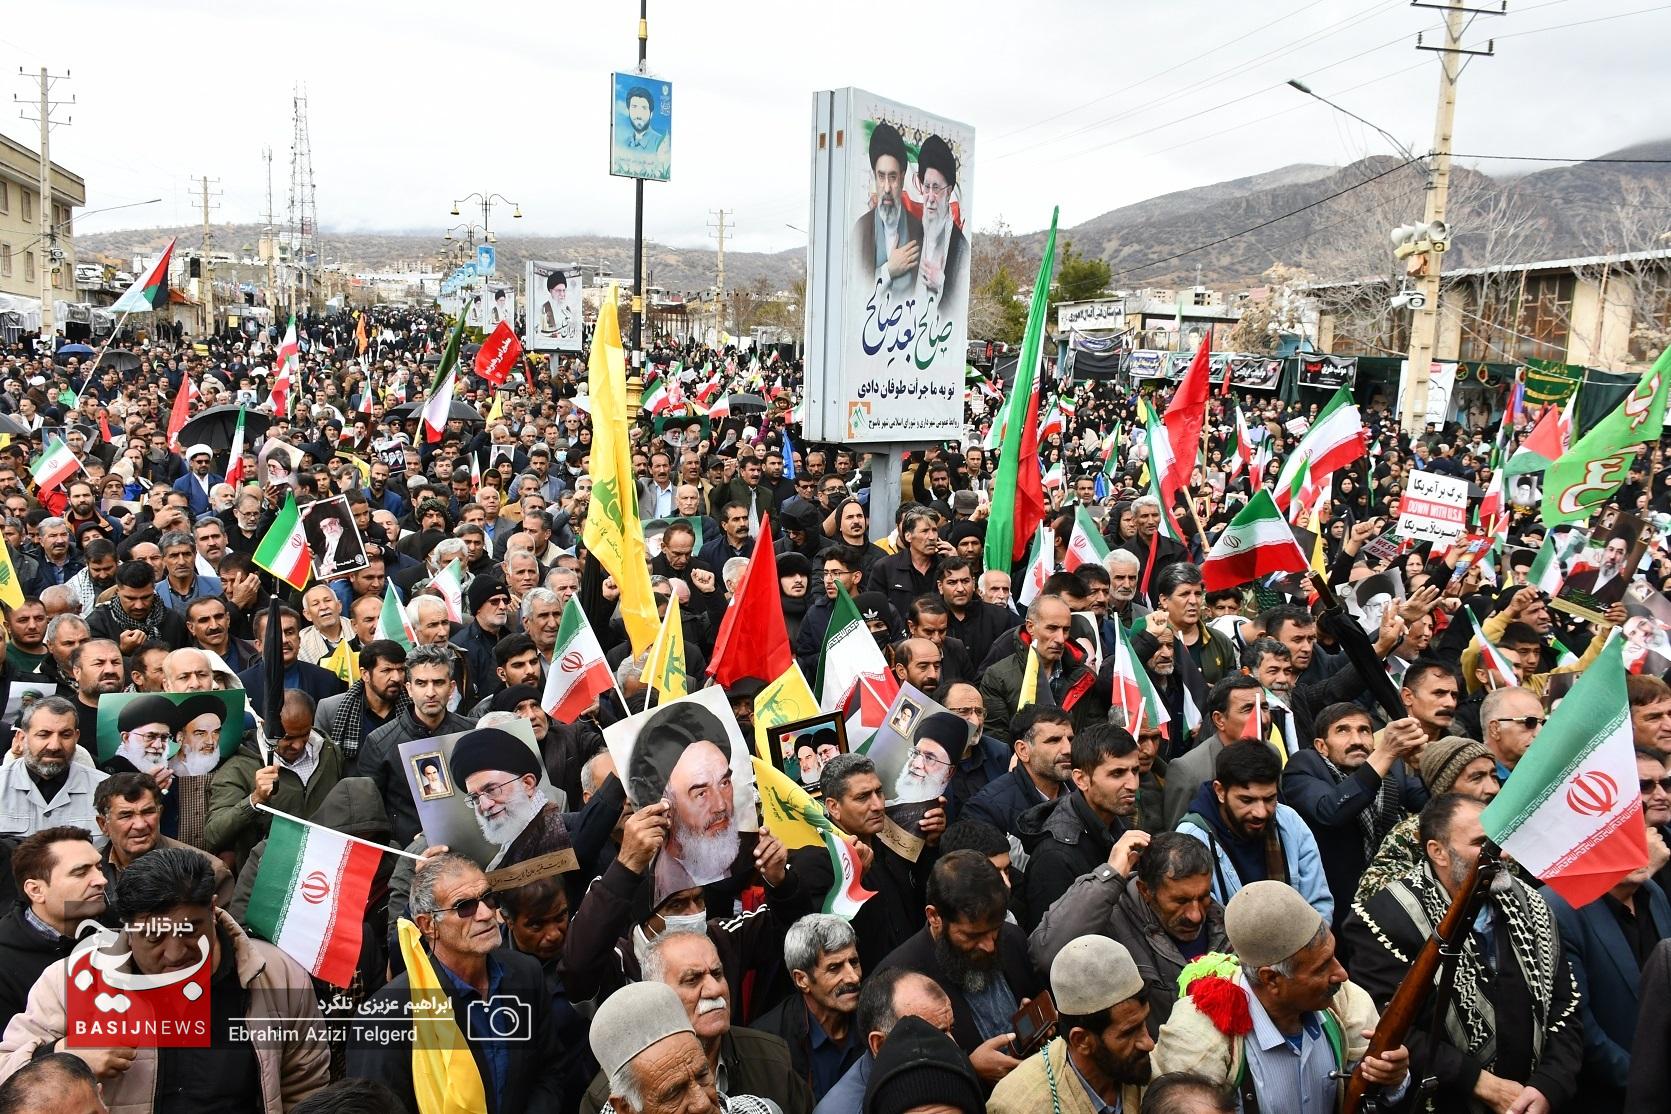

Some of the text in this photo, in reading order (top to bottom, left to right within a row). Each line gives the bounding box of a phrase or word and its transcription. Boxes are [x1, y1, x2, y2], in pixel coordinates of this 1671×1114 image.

[858, 379, 879, 398] دادی
[881, 378, 906, 399] طوفان
[930, 381, 937, 395] ما
[938, 384, 946, 399] به
[947, 382, 955, 400] تو
[936, 419, 948, 428] عمومی
[948, 417, 960, 428] روابط
[1407, 500, 1463, 522] DOWN WITH USA
